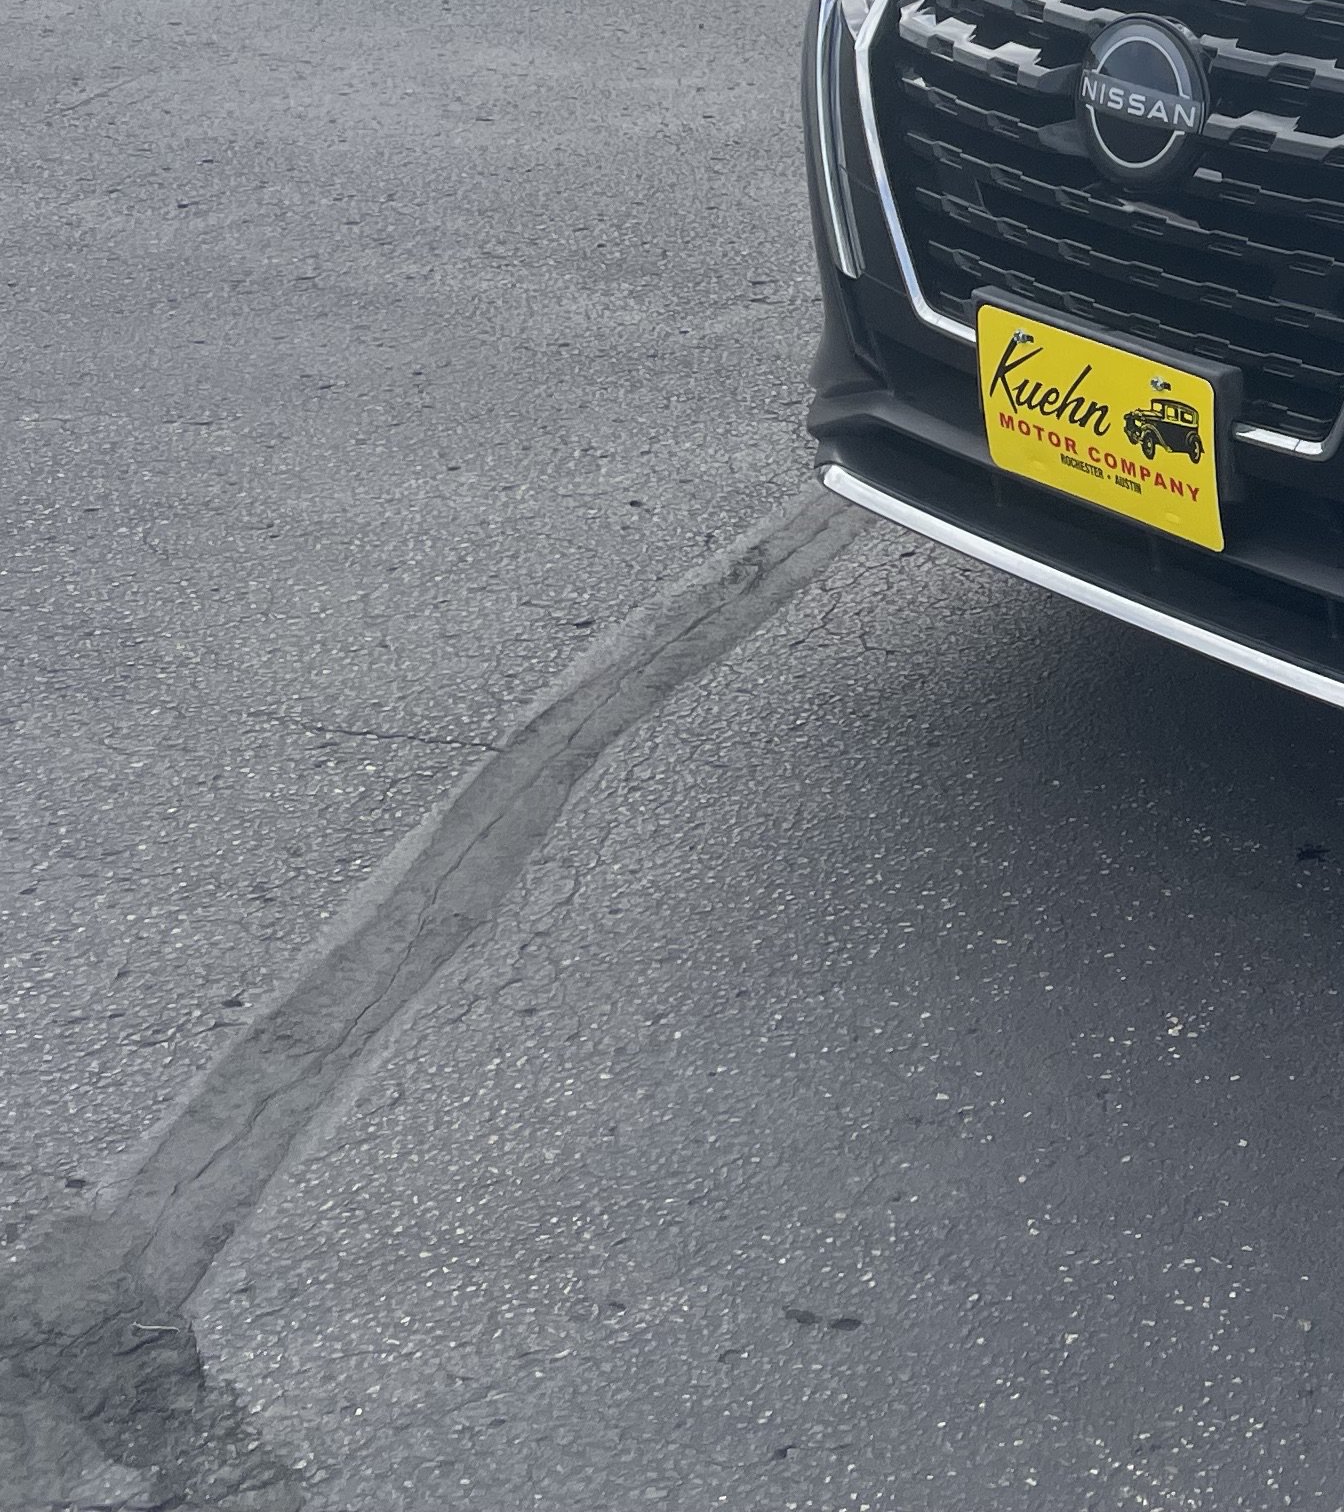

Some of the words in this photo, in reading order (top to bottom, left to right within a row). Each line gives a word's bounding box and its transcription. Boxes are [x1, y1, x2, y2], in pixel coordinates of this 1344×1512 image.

[1082, 76, 1196, 128] NISSAN
[990, 336, 1111, 437] Kuehn
[999, 411, 1079, 454] MOTOR
[1088, 446, 1200, 502] COMPANY
[1060, 453, 1104, 479] ROCHESTER
[1115, 474, 1142, 494] AUSTIN
